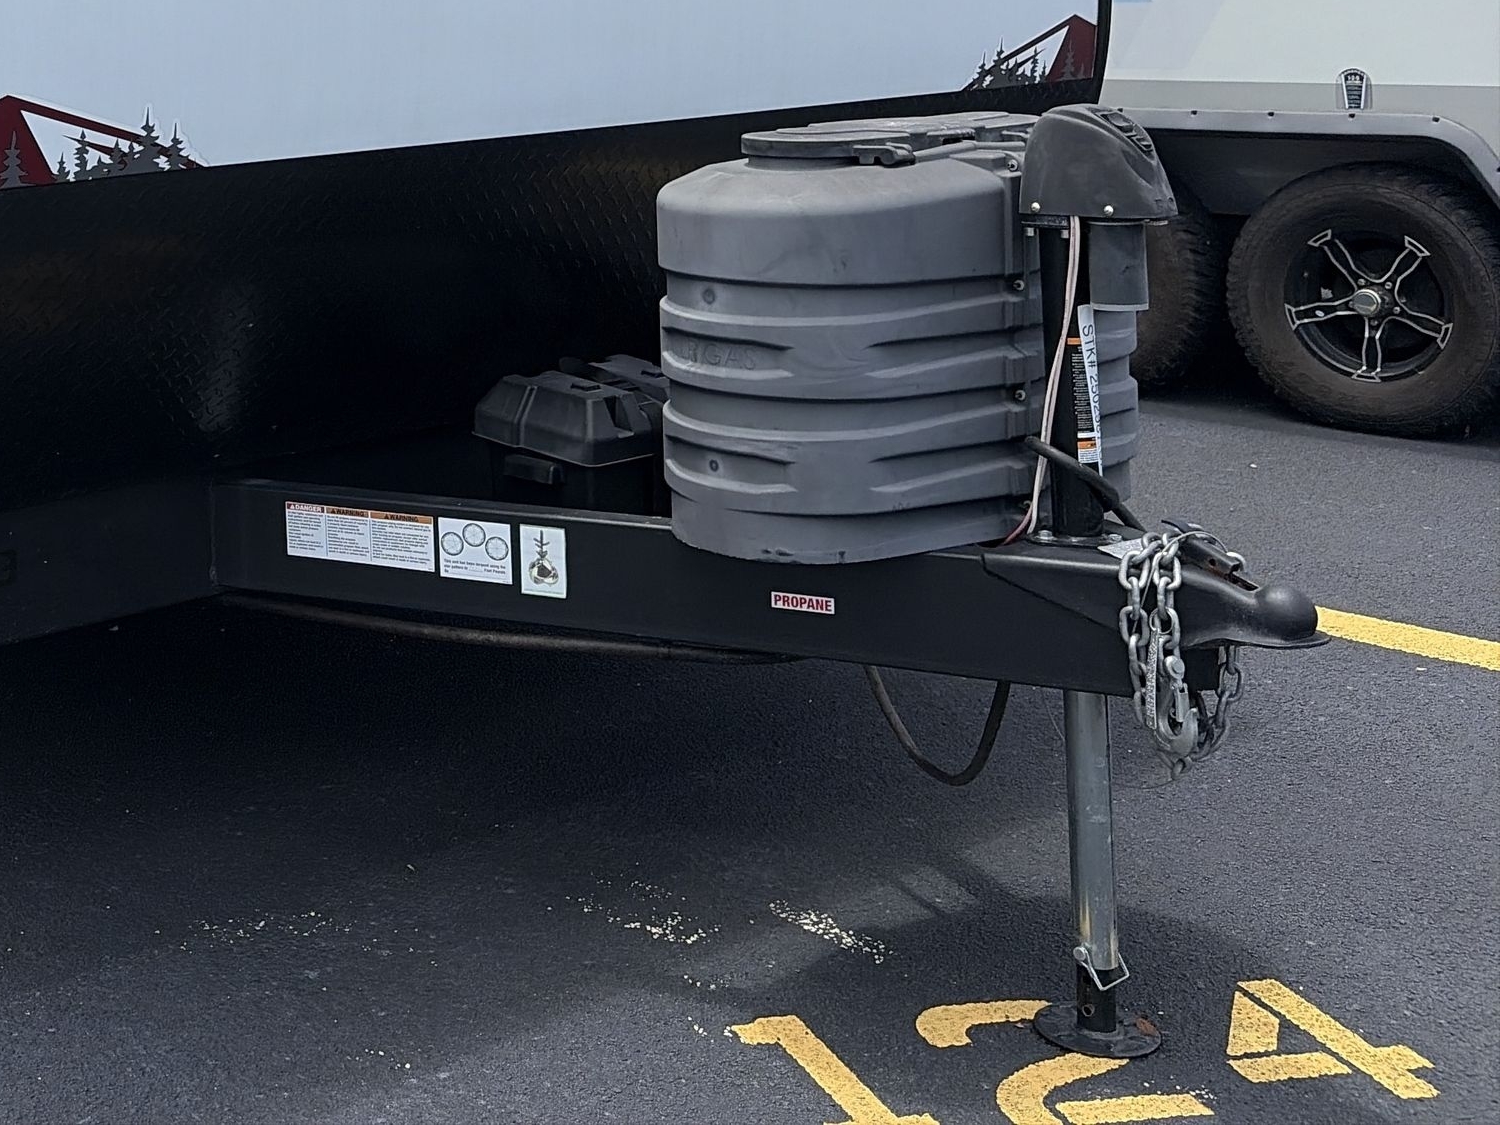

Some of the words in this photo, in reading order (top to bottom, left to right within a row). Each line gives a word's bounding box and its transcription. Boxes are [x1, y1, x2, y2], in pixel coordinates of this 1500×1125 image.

[1082, 324, 1096, 368] STK#
[295, 504, 322, 513] DANGER
[334, 509, 365, 517] WARNING
[390, 515, 419, 523] WARNING
[773, 594, 833, 612] PROPANE
